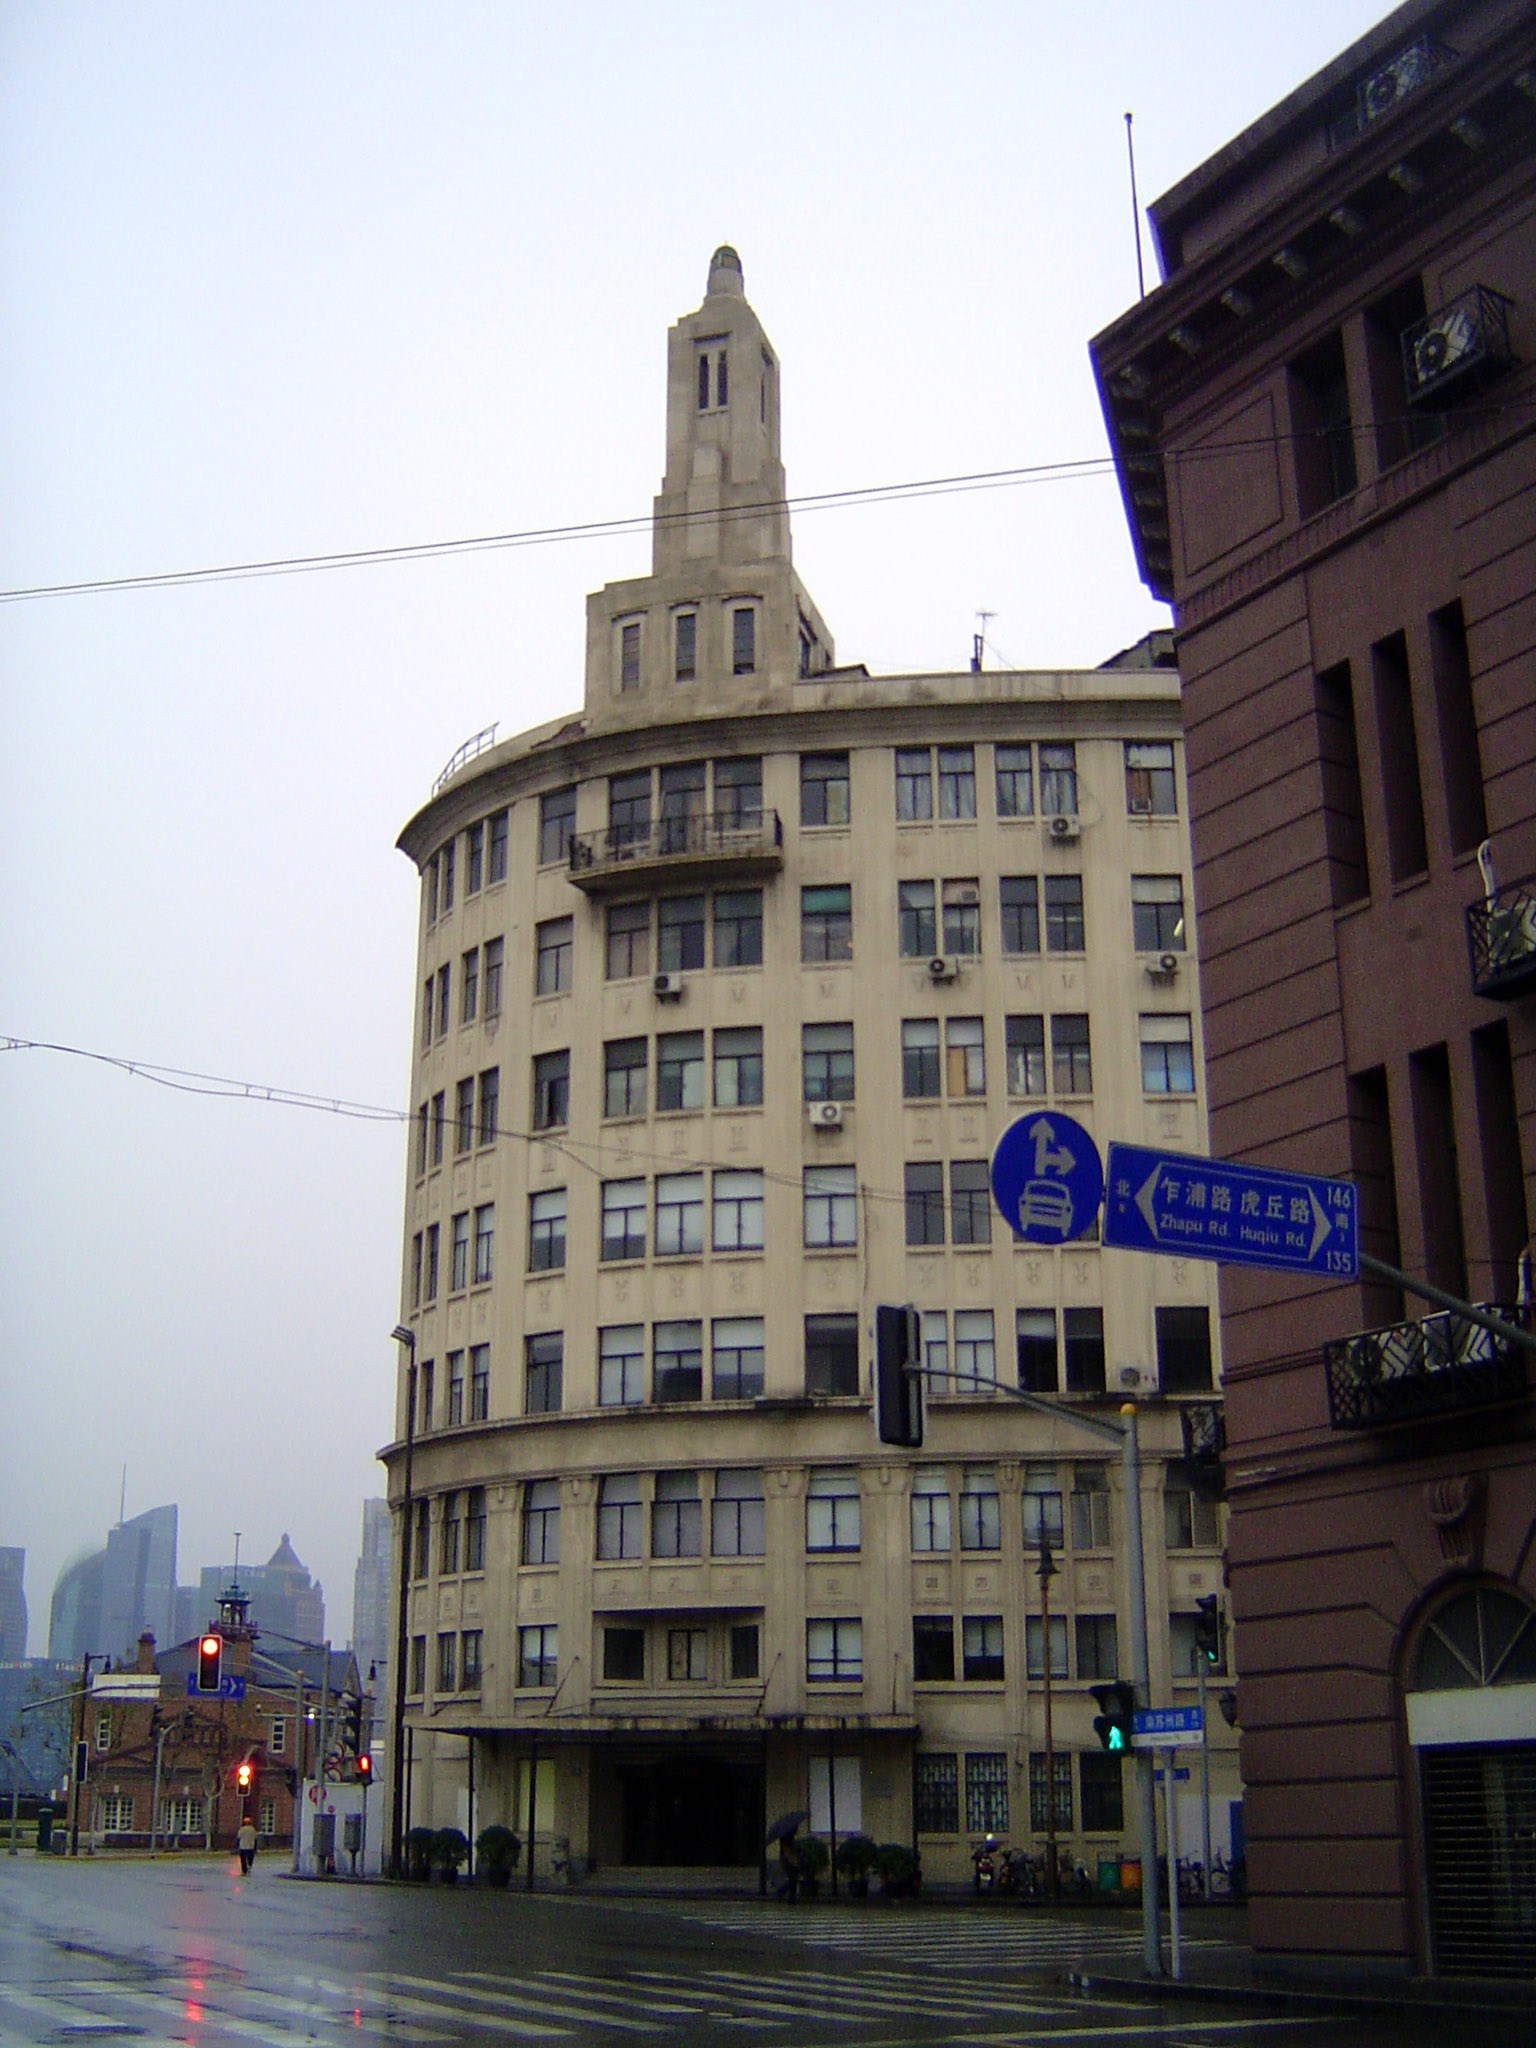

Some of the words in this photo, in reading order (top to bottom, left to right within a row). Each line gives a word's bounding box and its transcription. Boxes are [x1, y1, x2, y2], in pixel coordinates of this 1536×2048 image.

[1117, 1179, 1130, 1197] 北
[1327, 1185, 1350, 1208] 146
[1161, 1177, 1231, 1212] 乍浦路
[1240, 1189, 1309, 1225] 虎丘路
[1160, 1213, 1202, 1234] Zhapu
[1240, 1225, 1279, 1245] Huqiu
[1327, 1251, 1351, 1273] 135
